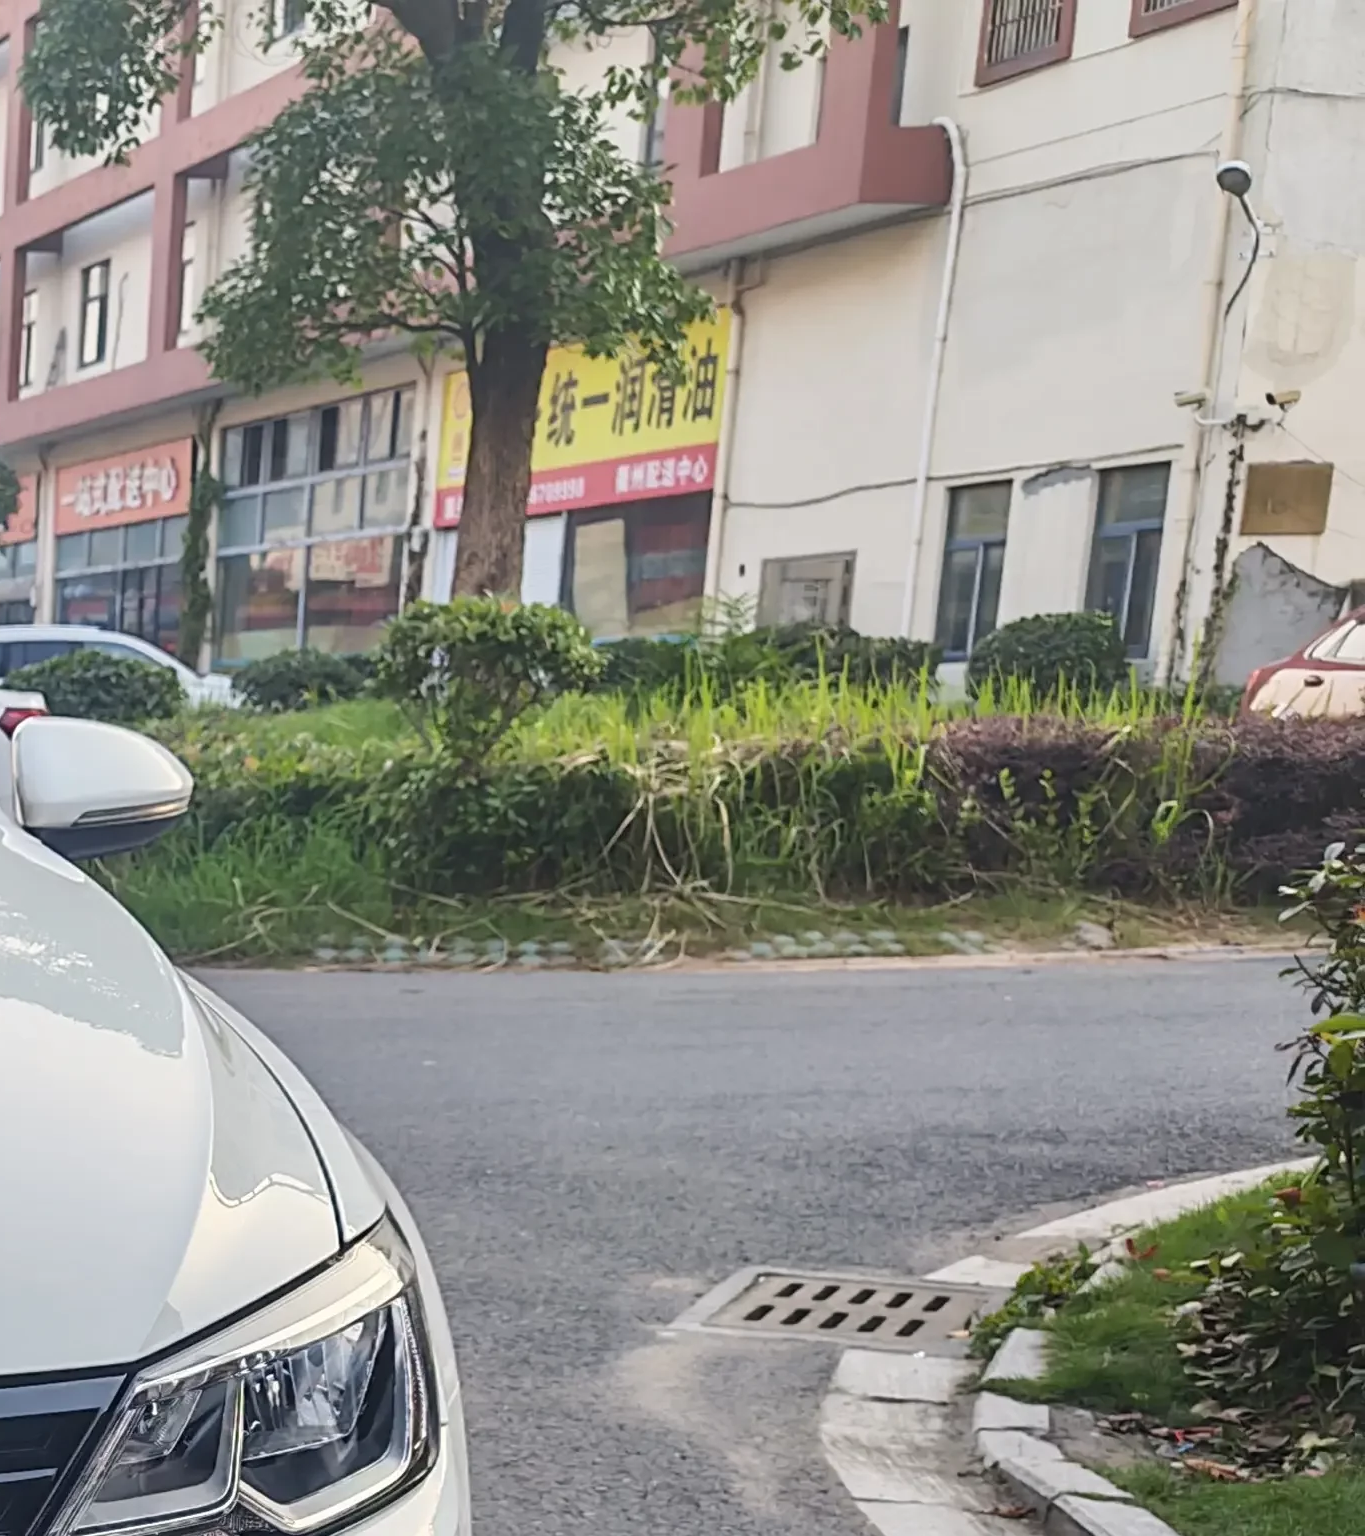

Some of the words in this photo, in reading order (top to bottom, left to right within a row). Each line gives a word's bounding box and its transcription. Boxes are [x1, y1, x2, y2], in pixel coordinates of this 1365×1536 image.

[546, 337, 719, 447] 统一润滑油
